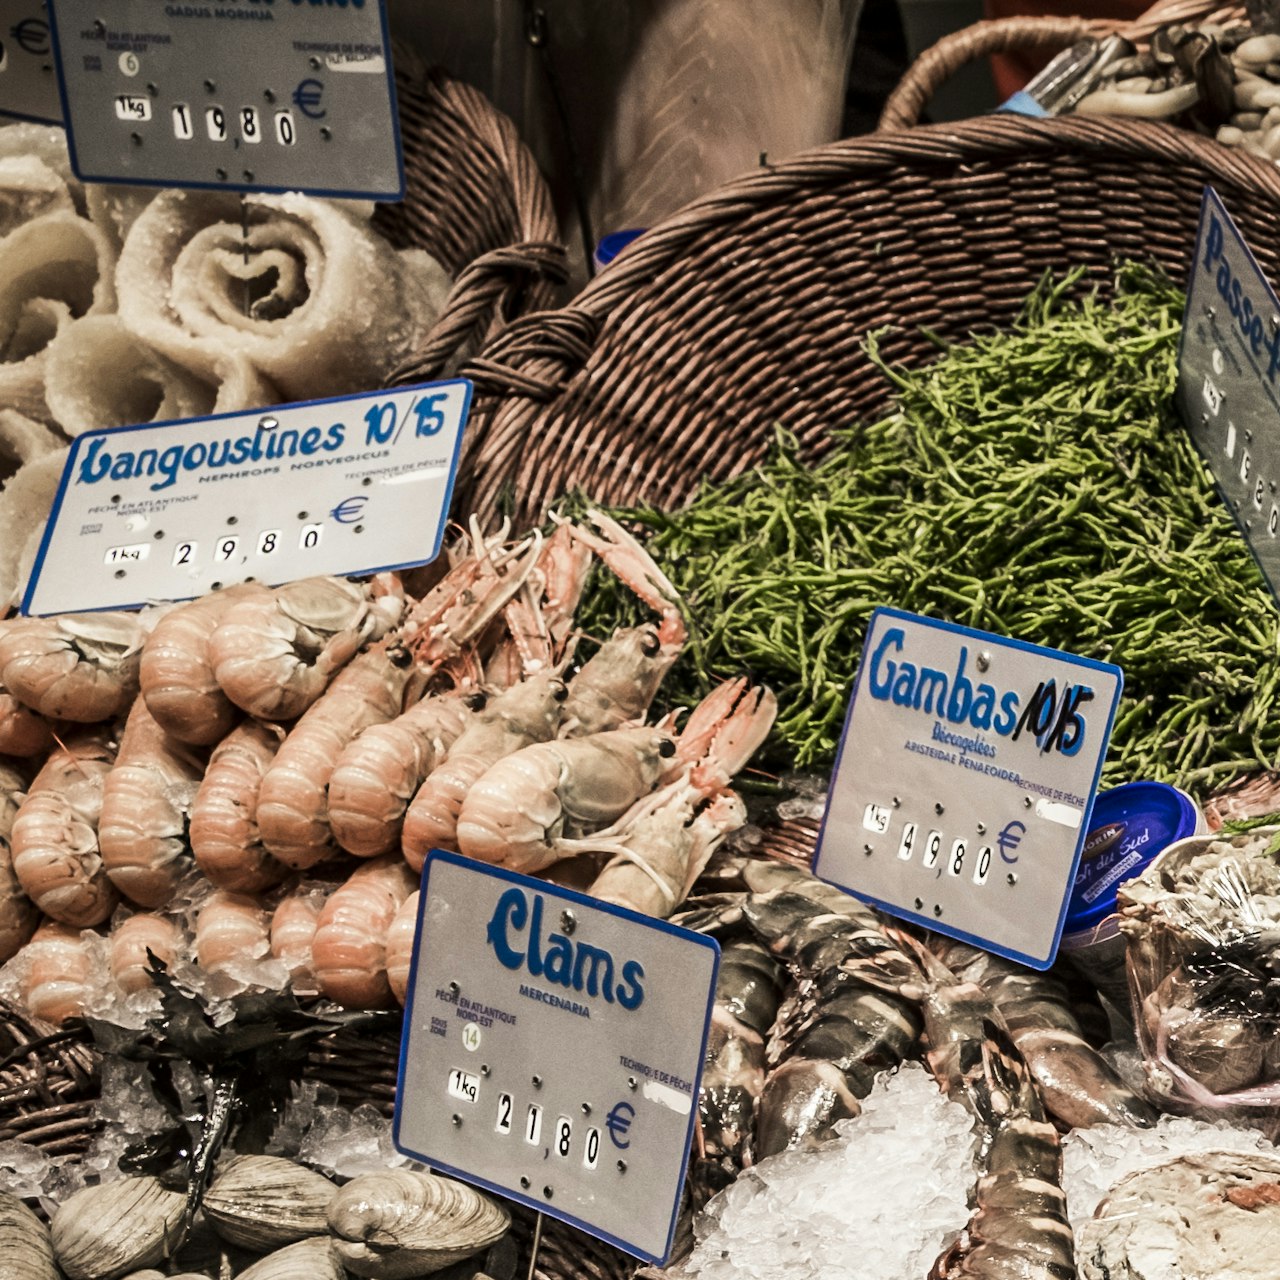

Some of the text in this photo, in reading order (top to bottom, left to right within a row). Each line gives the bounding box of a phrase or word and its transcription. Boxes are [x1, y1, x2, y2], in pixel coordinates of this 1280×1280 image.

[126, 55, 136, 71] 6
[119, 96, 145, 118] 1kg
[75, 393, 450, 492] Langoustines 10/15
[198, 450, 391, 484] NEPHROPS NORVEGICUS
[138, 493, 200, 508] ATLANTIQUE
[868, 627, 1020, 737] Gambas
[958, 755, 1021, 786] PENAEOIDEA
[1053, 790, 1065, 801] DE
[1119, 827, 1151, 856] Sud
[487, 886, 646, 1011] Clams
[460, 997, 517, 1026] EN ATLANTIQUE
[518, 984, 591, 1019] MERCENARIA
[456, 1008, 494, 1028] NORD-EST
[464, 1028, 478, 1046] 14
[456, 1071, 477, 1102] 1kg
